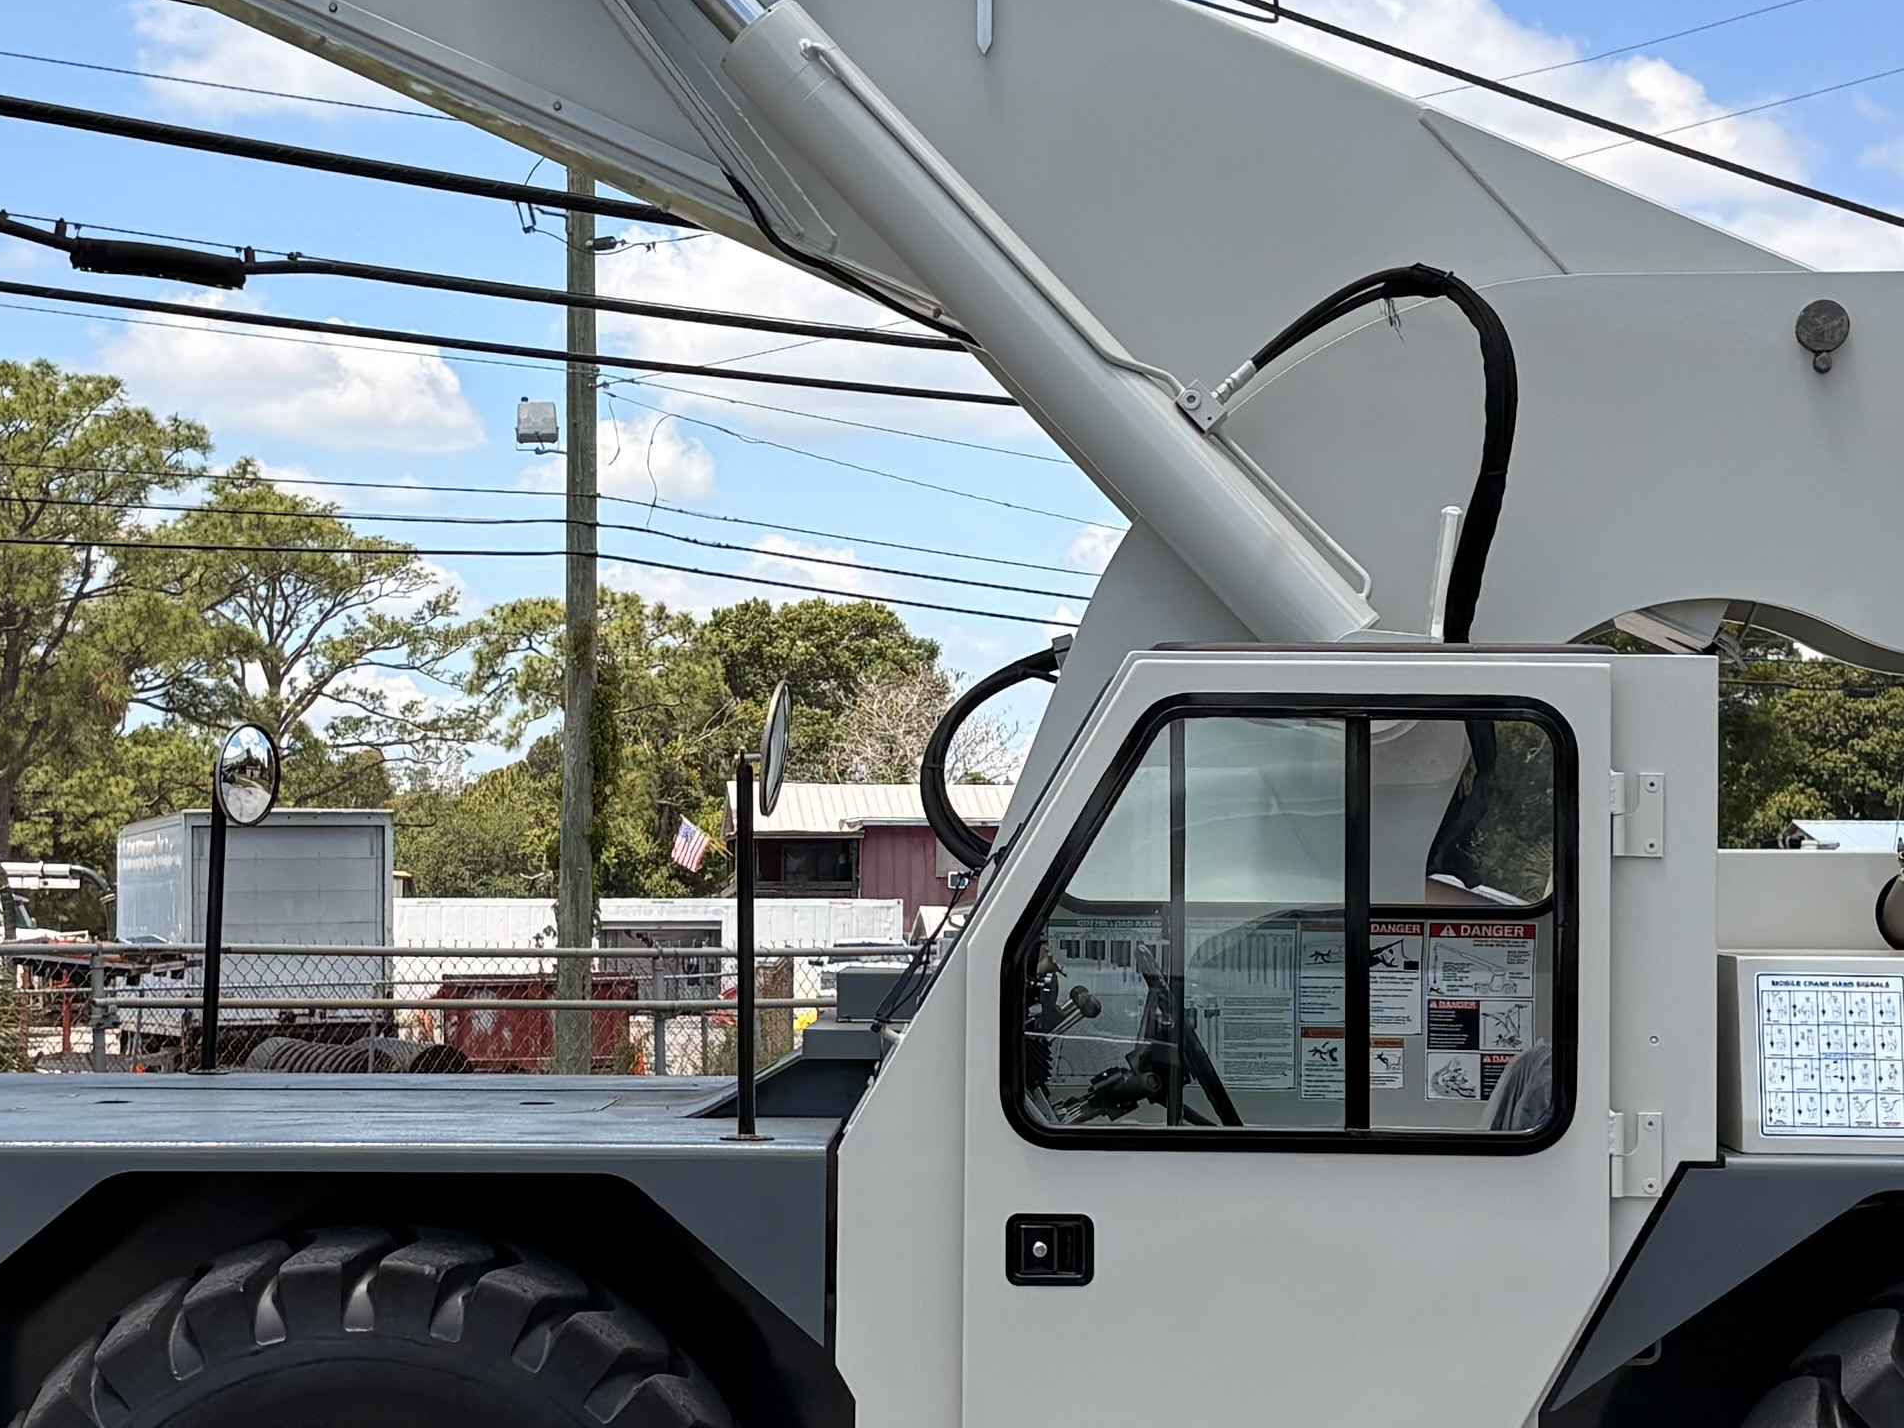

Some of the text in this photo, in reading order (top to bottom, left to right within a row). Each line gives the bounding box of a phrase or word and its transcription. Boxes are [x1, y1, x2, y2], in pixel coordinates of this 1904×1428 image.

[1370, 923, 1421, 933] DANGER
[1460, 924, 1524, 937] DANGER
[1438, 1001, 1477, 1009] DANGER
